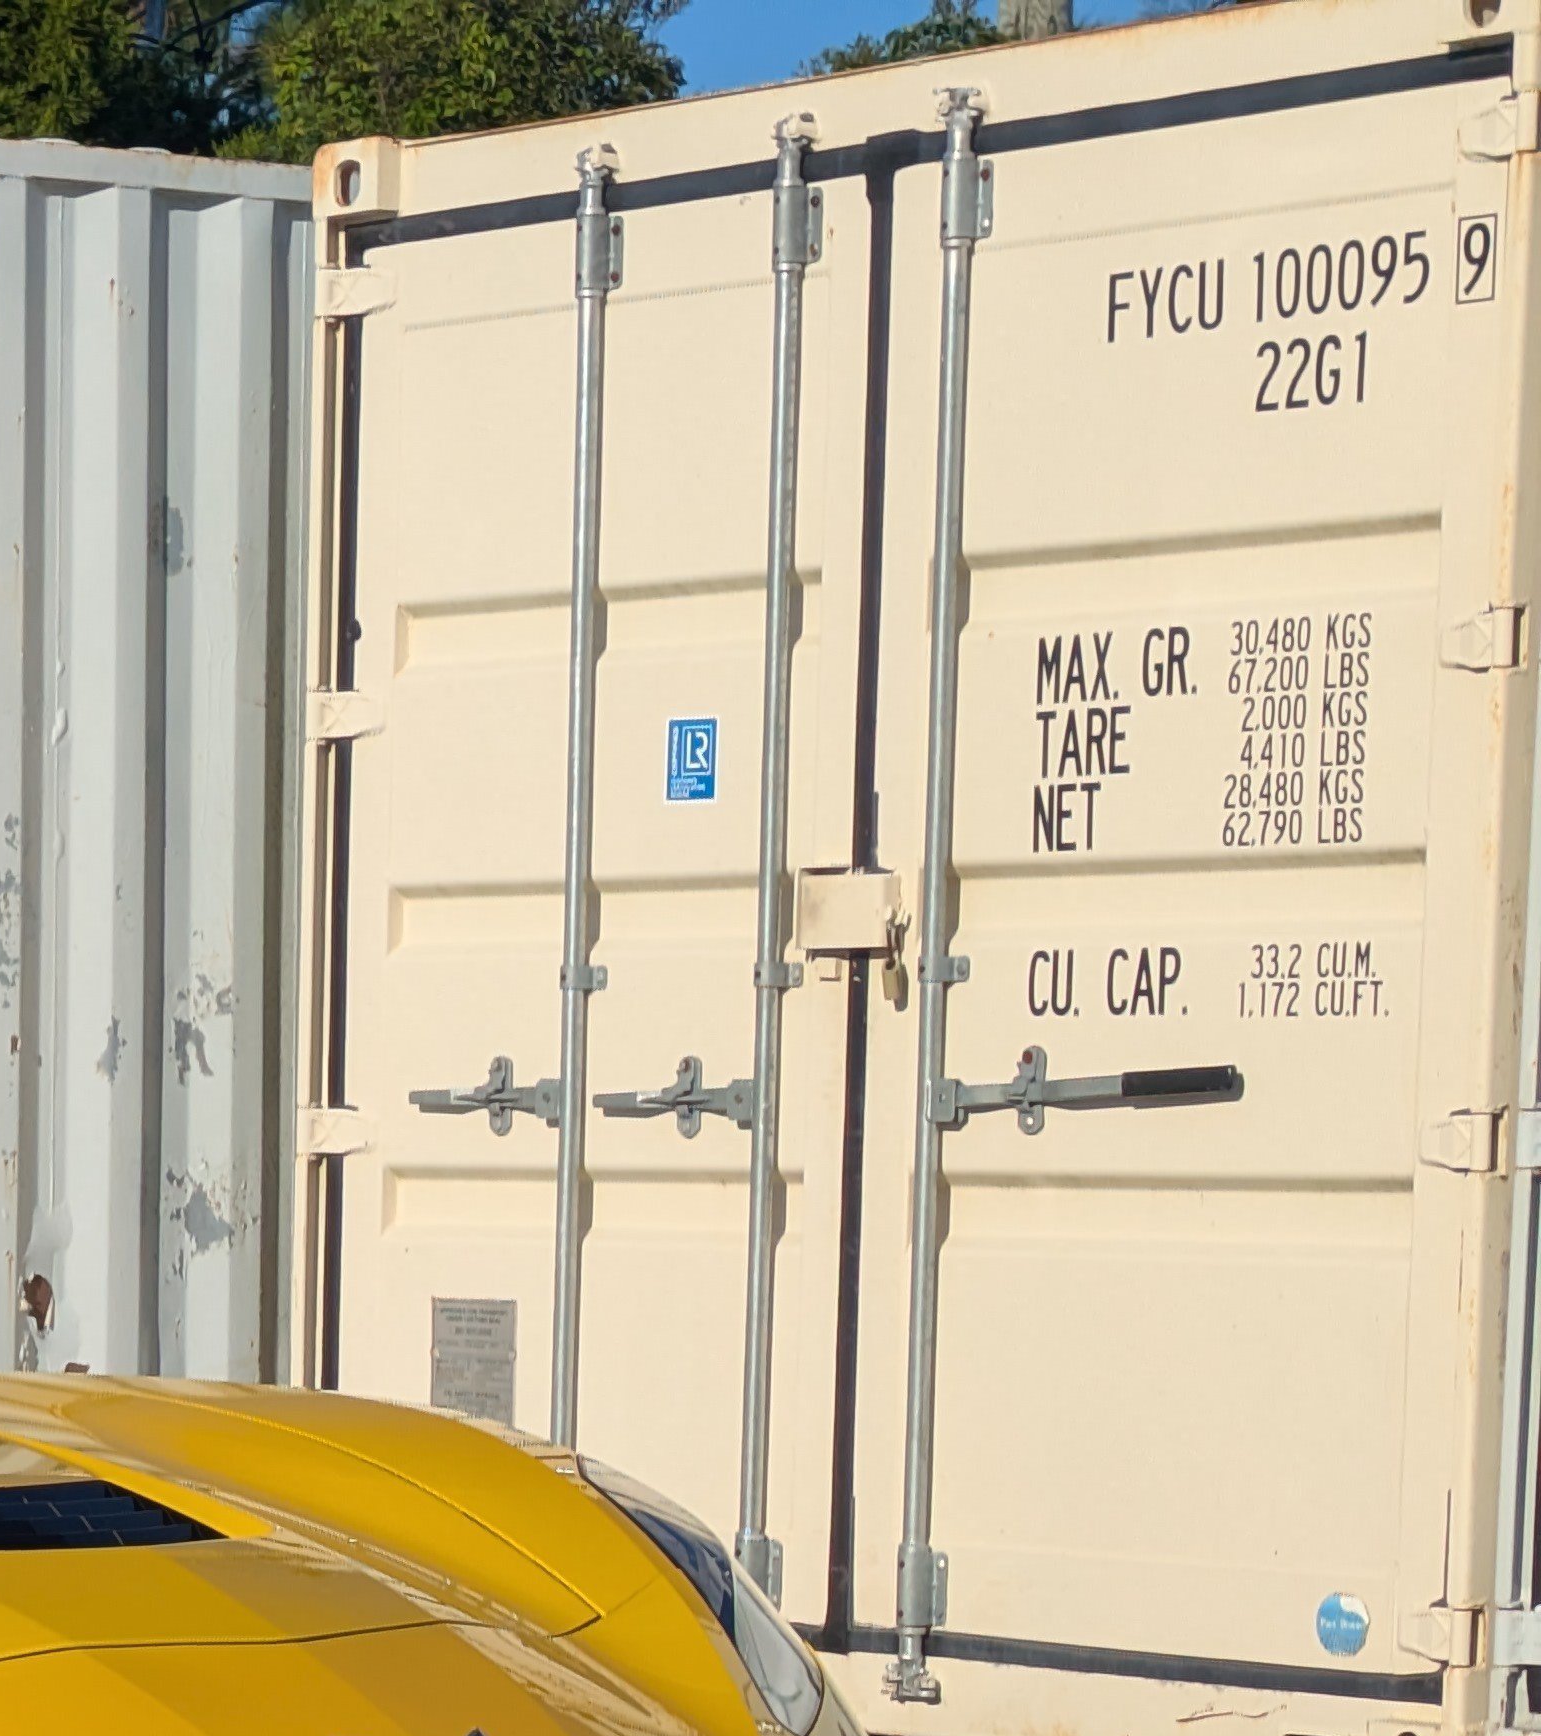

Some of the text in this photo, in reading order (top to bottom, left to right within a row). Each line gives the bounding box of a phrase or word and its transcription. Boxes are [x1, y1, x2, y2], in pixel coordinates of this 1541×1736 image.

[1107, 222, 1493, 344] FYCU 100095 9
[1254, 330, 1367, 413] 22G1
[1230, 612, 1372, 656] 30,480 KGS
[1036, 626, 1198, 704] MAX. GR.
[1228, 651, 1370, 695] 67,200 LBS
[1321, 690, 1368, 728] KGS
[685, 730, 708, 770] LR
[1035, 704, 1132, 779] TARE
[1240, 729, 1366, 771] 4,410 LBS
[1223, 768, 1365, 809] 28,480 KGS
[1032, 780, 1102, 853] NET
[1222, 807, 1363, 847] 62,790 LBS
[1028, 946, 1188, 1017] CU. CAP.
[1316, 941, 1377, 979] CU.M.
[1239, 979, 1389, 1018] 1,172 CU.FT.
